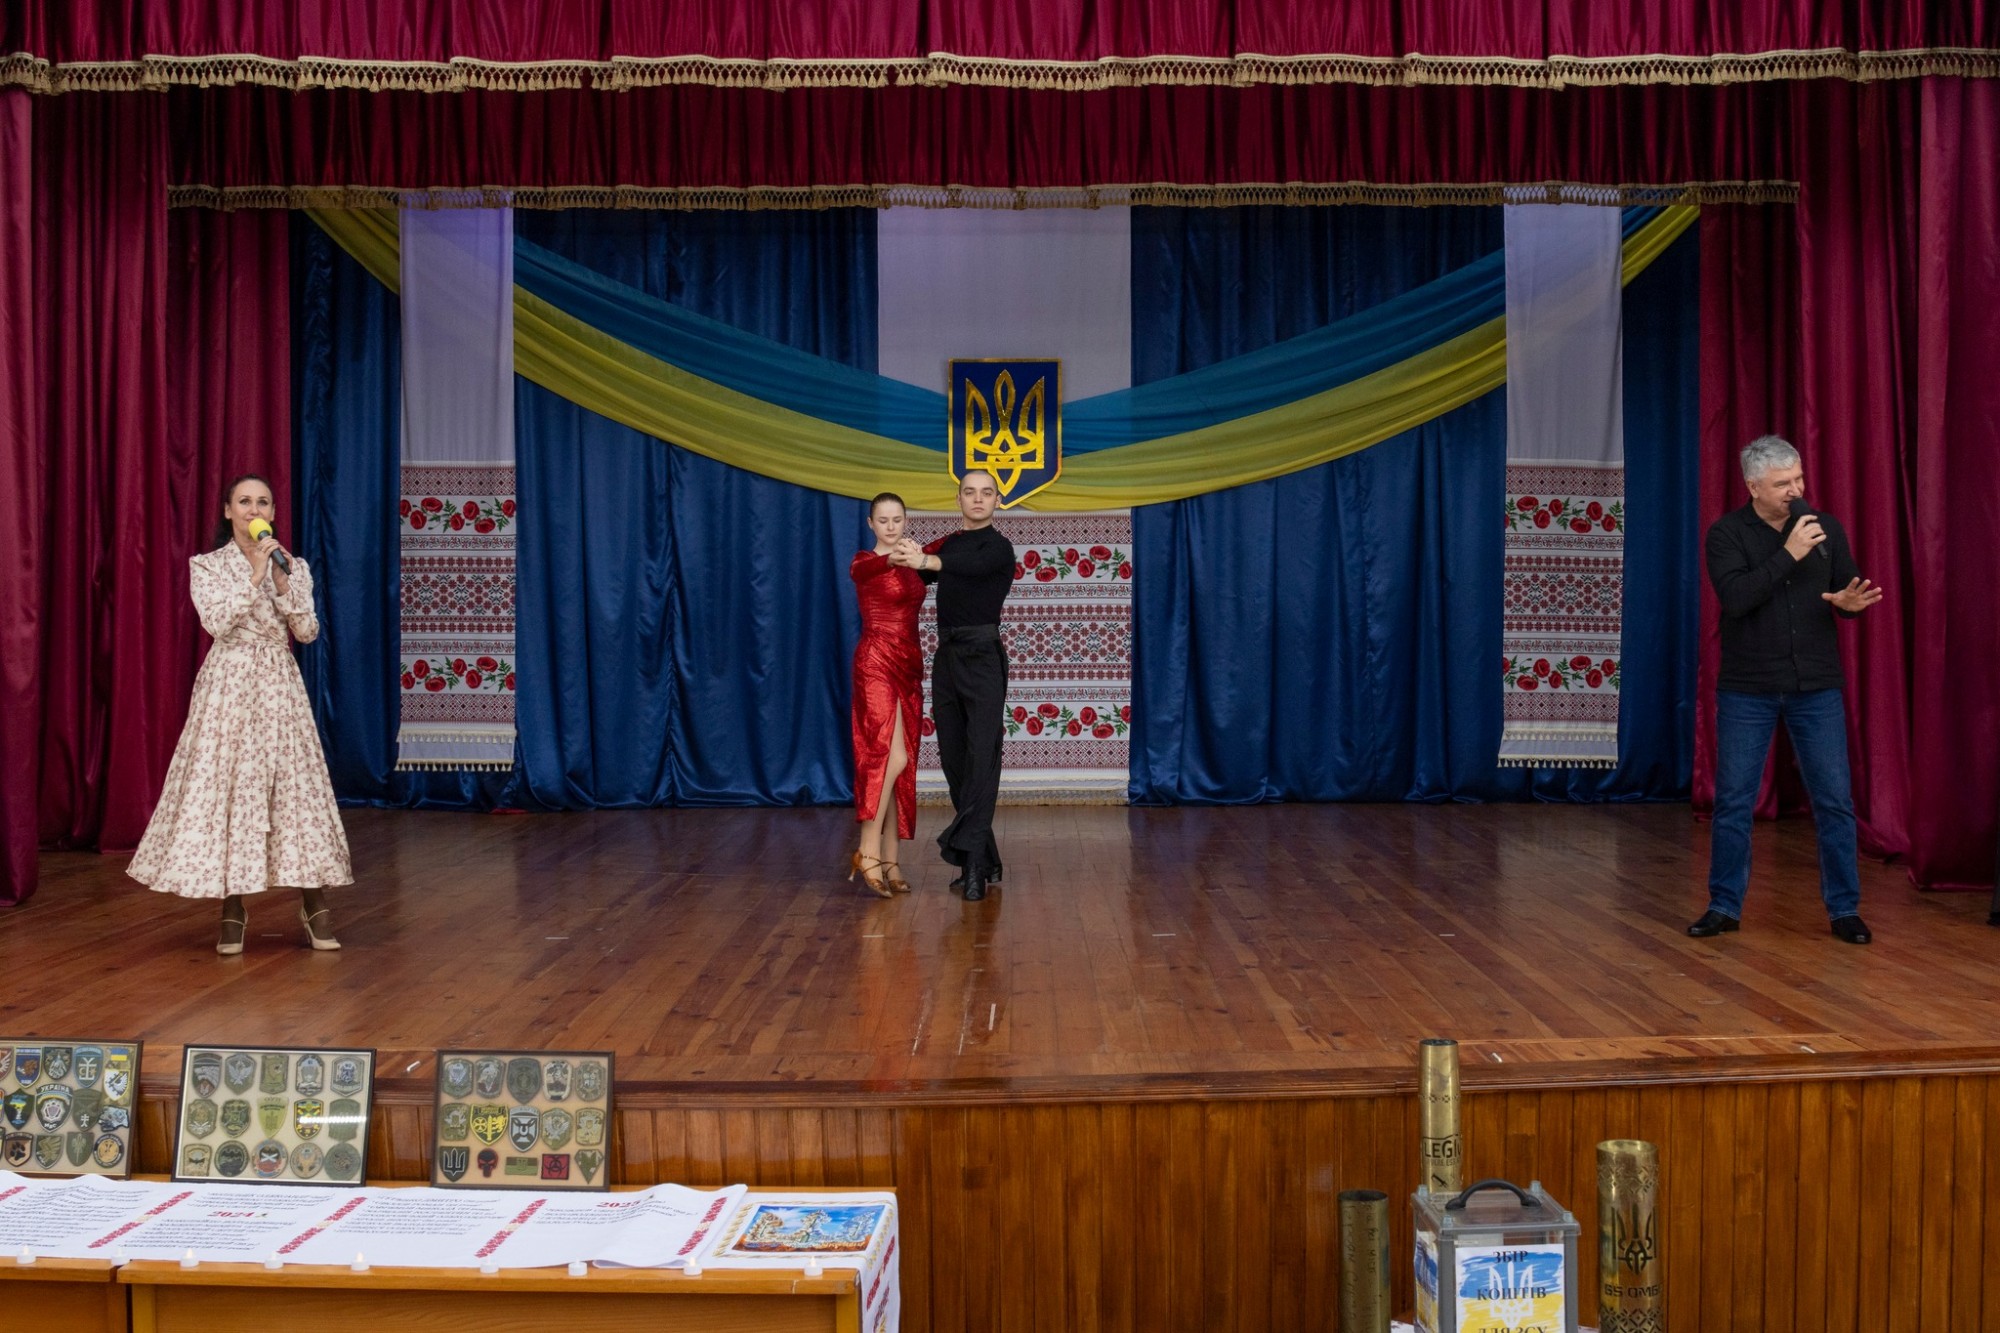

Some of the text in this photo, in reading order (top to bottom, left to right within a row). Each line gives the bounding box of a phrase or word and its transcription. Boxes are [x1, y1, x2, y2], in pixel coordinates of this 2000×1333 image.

[40, 1084, 70, 1093] УКРАЇНА
[1492, 1250, 1528, 1264] ЗБІР
[1477, 1286, 1547, 1301] КОШТІВ
